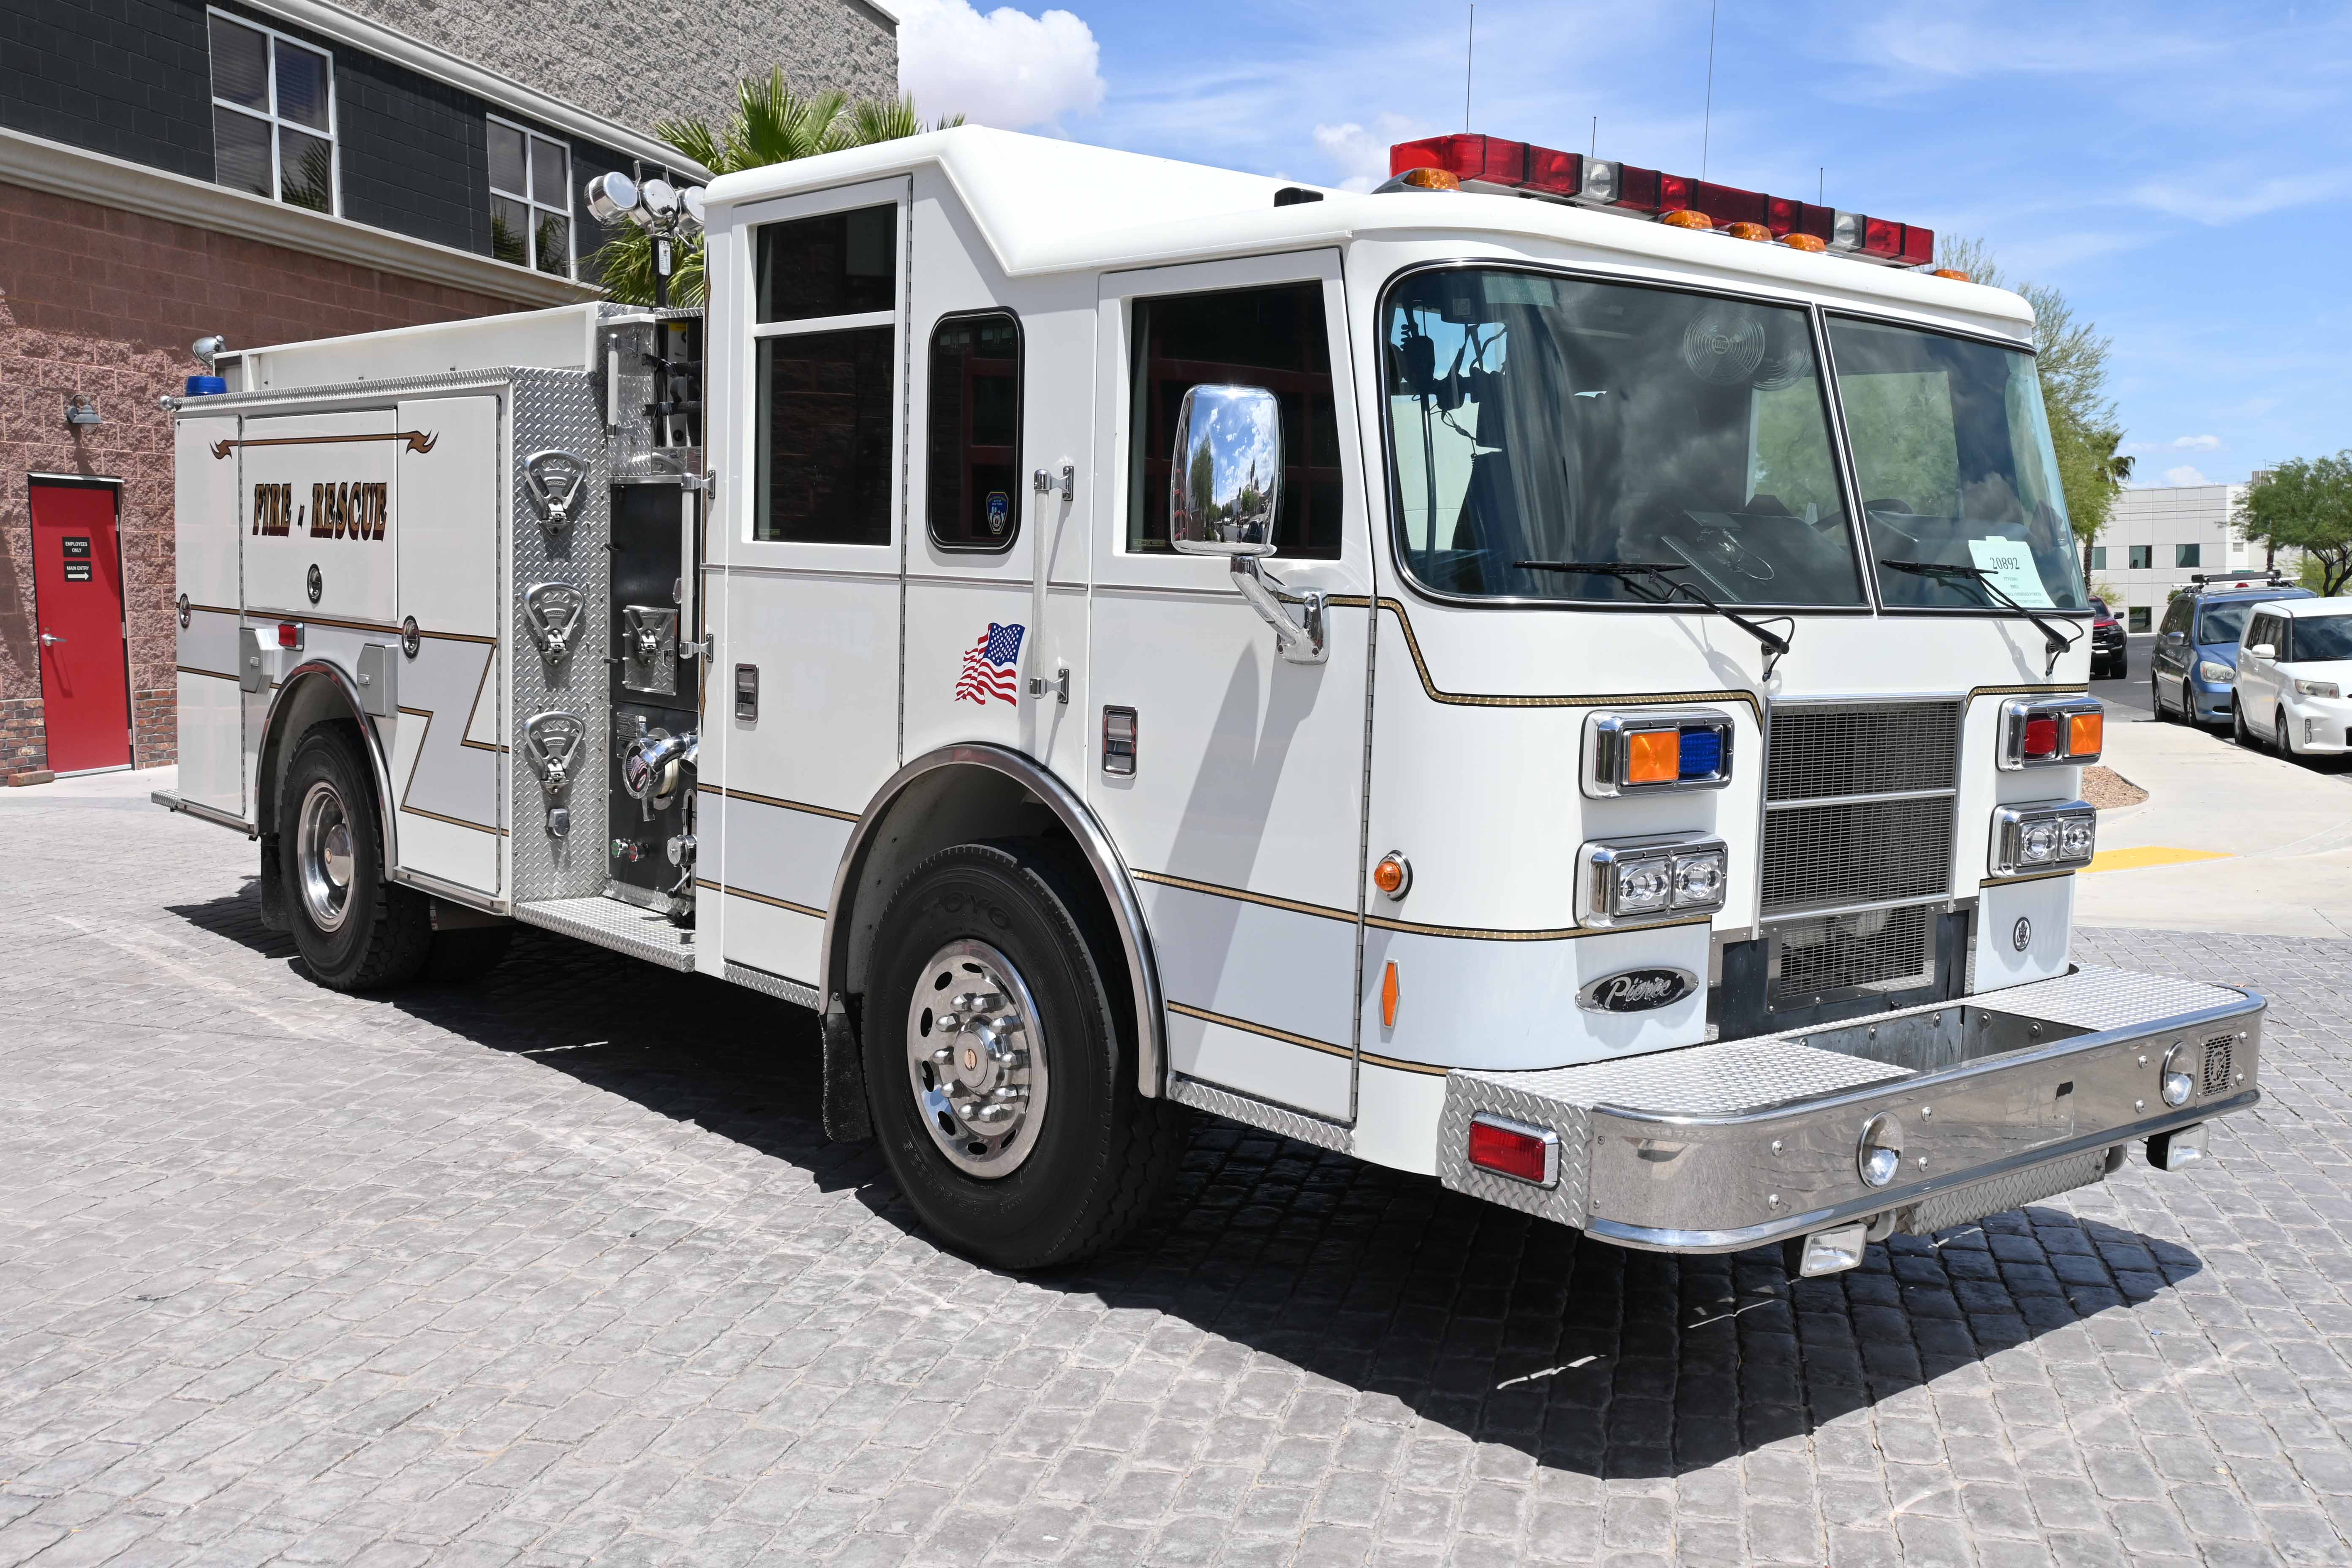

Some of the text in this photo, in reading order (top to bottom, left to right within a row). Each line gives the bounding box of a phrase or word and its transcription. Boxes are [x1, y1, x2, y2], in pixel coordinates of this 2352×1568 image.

[252, 482, 291, 537] FIRE
[310, 481, 387, 542] RESCUE
[1990, 557, 2020, 569] 20892
[1605, 976, 1671, 1008] Pierce
